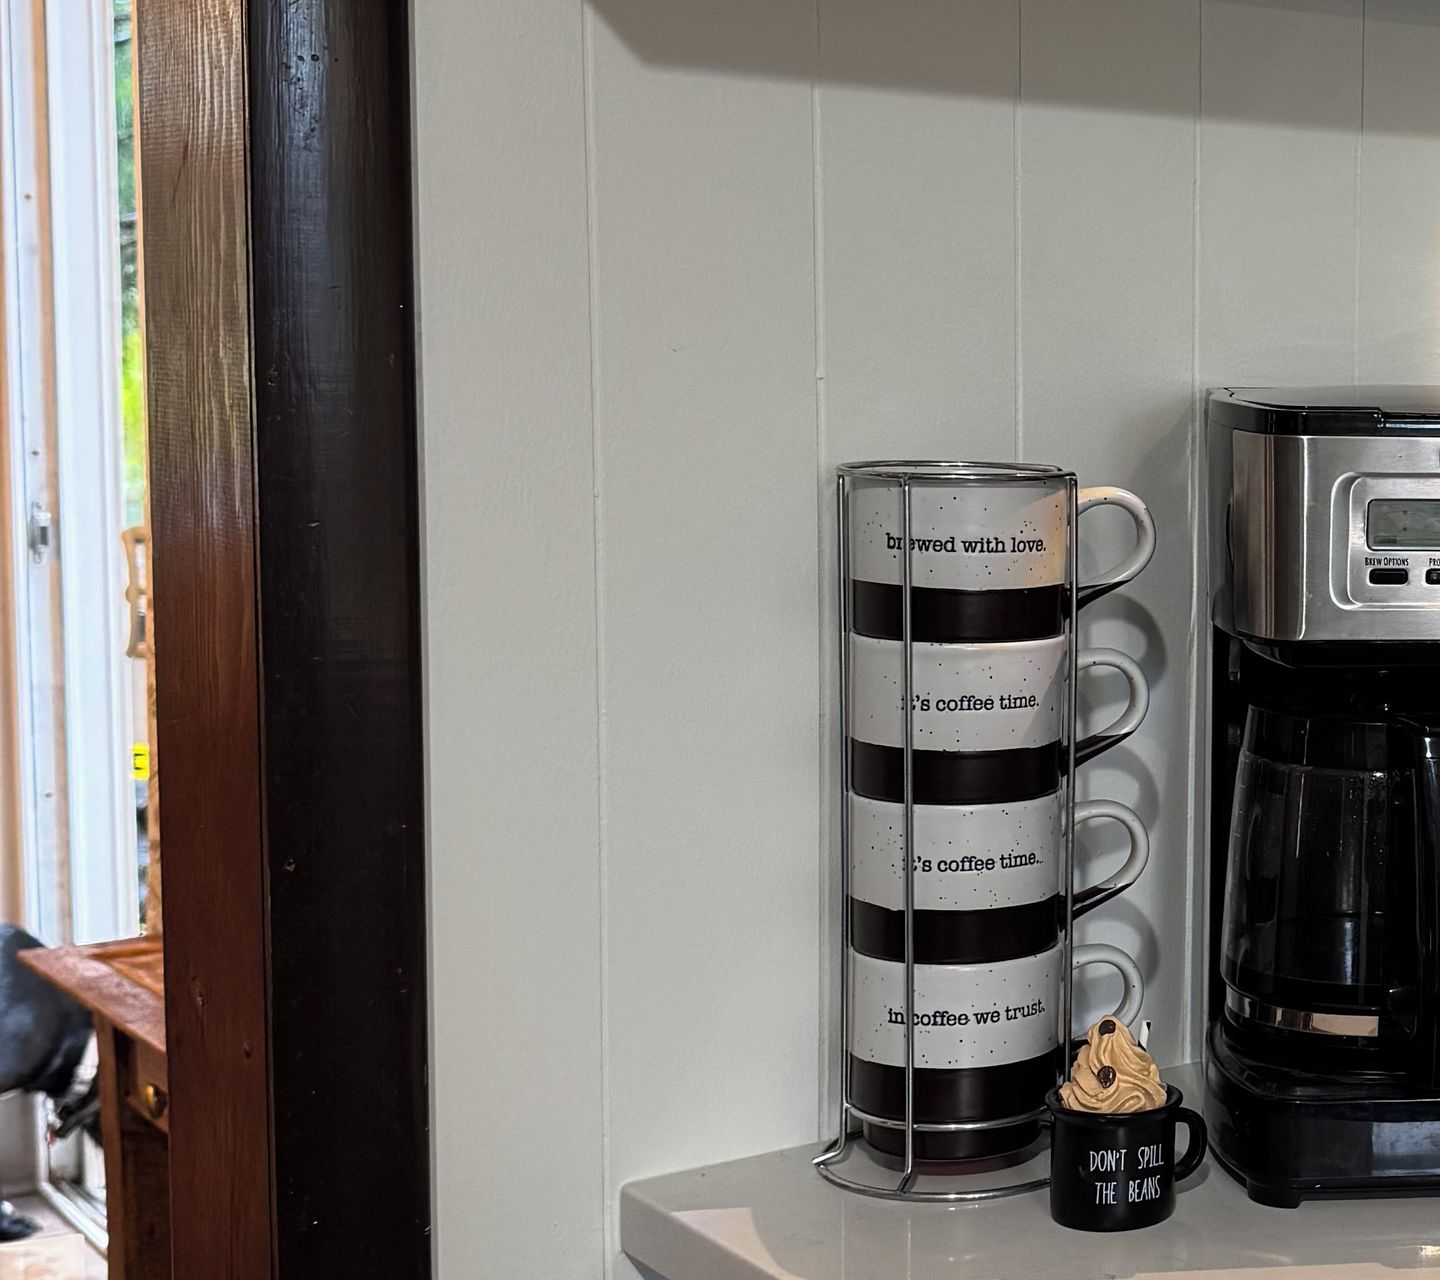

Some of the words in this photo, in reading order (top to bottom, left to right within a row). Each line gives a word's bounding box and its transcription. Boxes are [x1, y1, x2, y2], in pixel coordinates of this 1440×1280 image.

[885, 532, 957, 553] brewed
[961, 537, 1006, 553] with
[1010, 537, 1047, 553] love.
[935, 694, 995, 711] coffee
[999, 693, 1040, 710] time.
[937, 856, 996, 872] coffee
[888, 1008, 905, 1025] in
[912, 1010, 970, 1026] coffee
[973, 1010, 1001, 1025] we
[1005, 998, 1046, 1021] trust.
[1089, 1149, 1128, 1172] DON'T
[1137, 1143, 1164, 1169] SPILL
[1095, 1181, 1117, 1205] THE
[1128, 1175, 1161, 1203] BEANS
